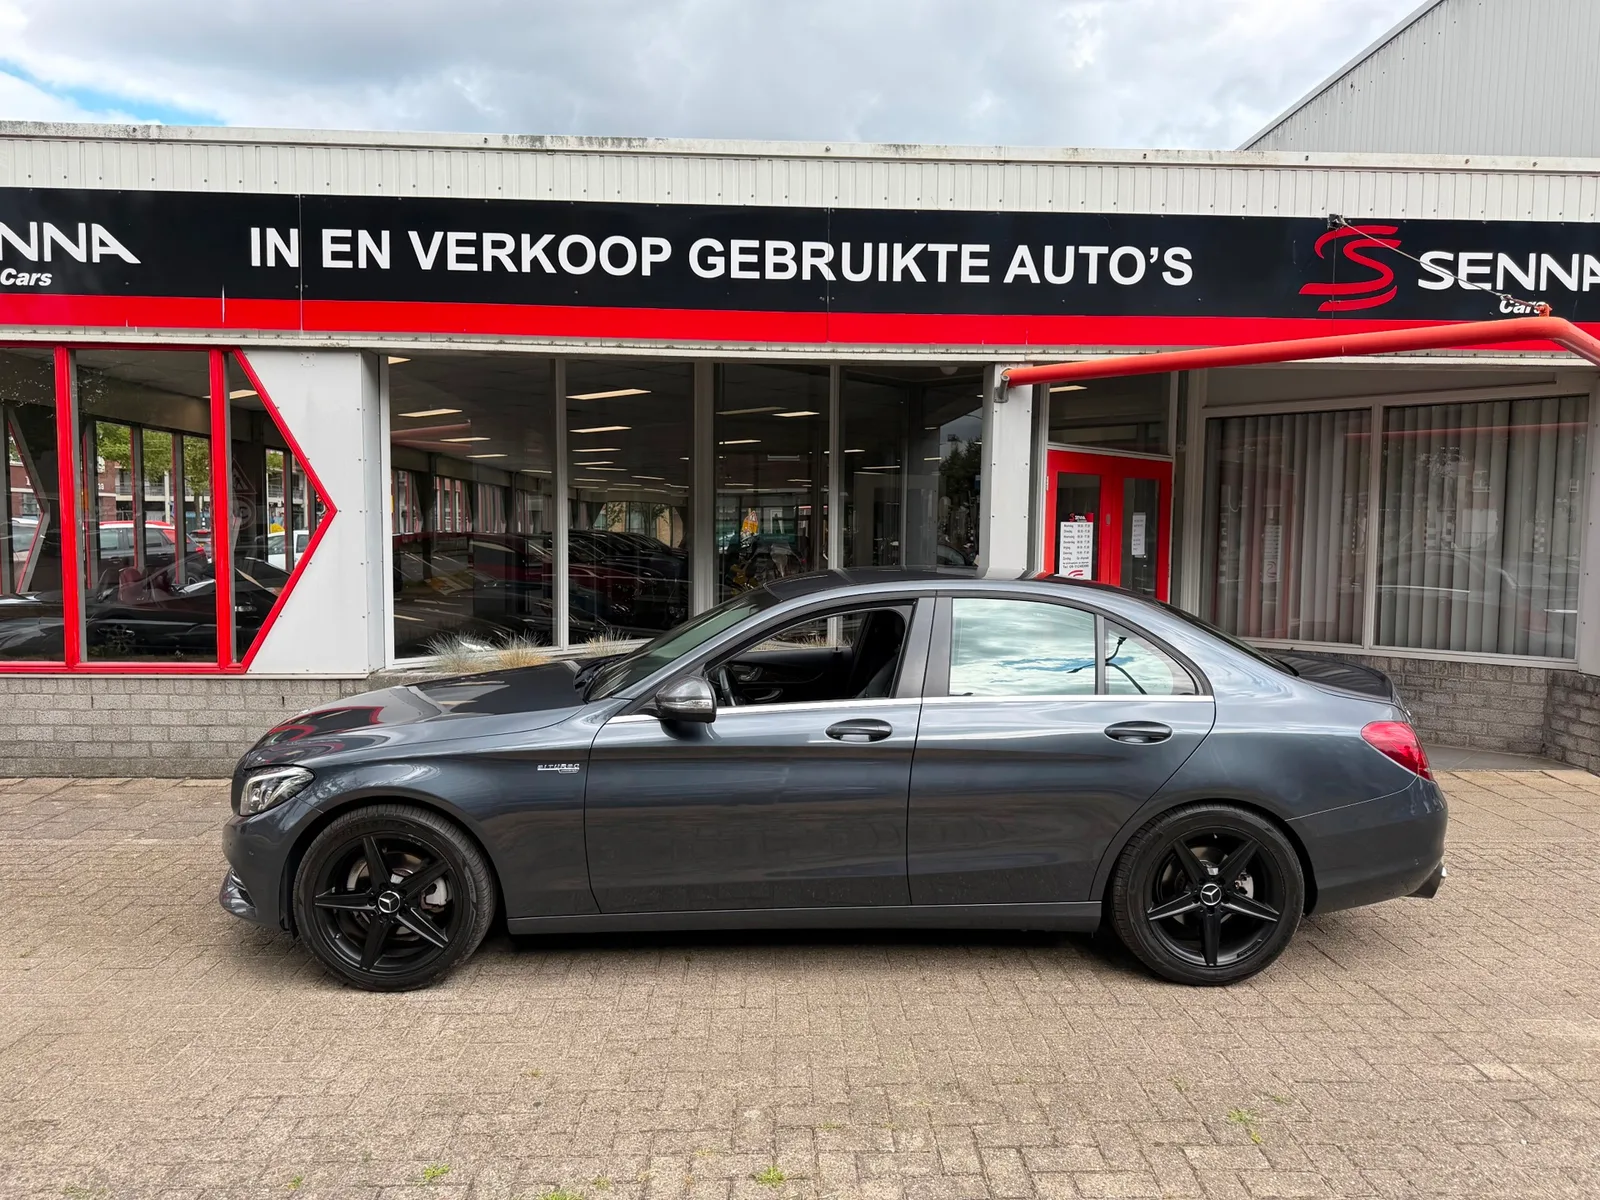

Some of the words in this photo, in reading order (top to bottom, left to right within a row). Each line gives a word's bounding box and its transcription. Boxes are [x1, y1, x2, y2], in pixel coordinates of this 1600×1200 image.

[250, 227, 299, 268] IN
[321, 228, 391, 270] EN
[408, 230, 672, 277] VERKOOP
[688, 236, 990, 283] GEBRUIKTE
[1003, 244, 1193, 286] AUTO’S
[0, 267, 53, 287] Cars
